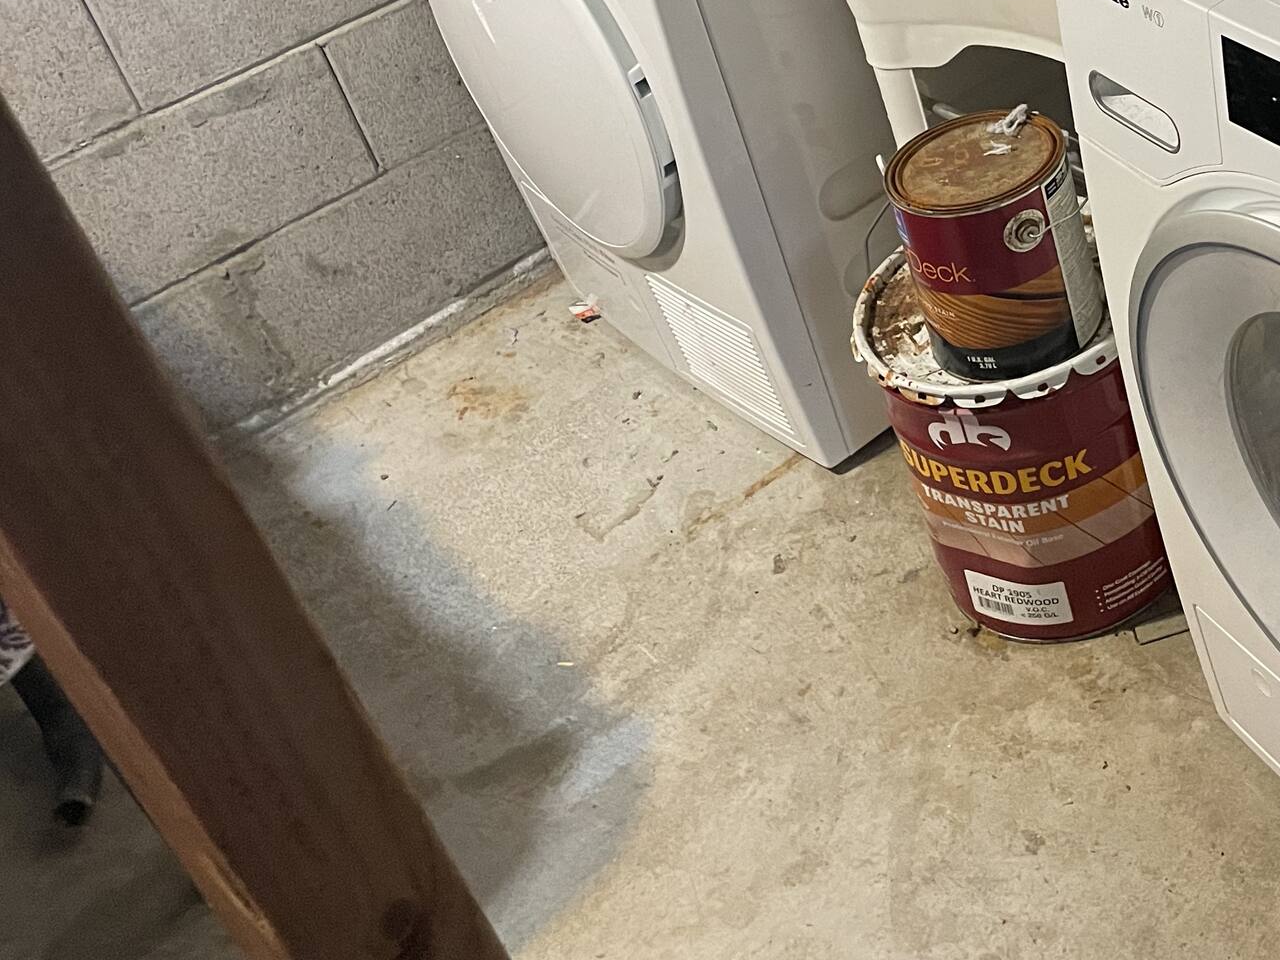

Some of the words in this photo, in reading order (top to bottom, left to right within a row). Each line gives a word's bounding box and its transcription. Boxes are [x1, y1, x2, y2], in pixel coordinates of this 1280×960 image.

[900, 439, 1092, 495] SUPERDECK
[921, 483, 1070, 519] TRANSPARENT
[964, 511, 1025, 534] STAIN
[973, 586, 1002, 600] HEART
[1004, 594, 1060, 606] REDWOOD
